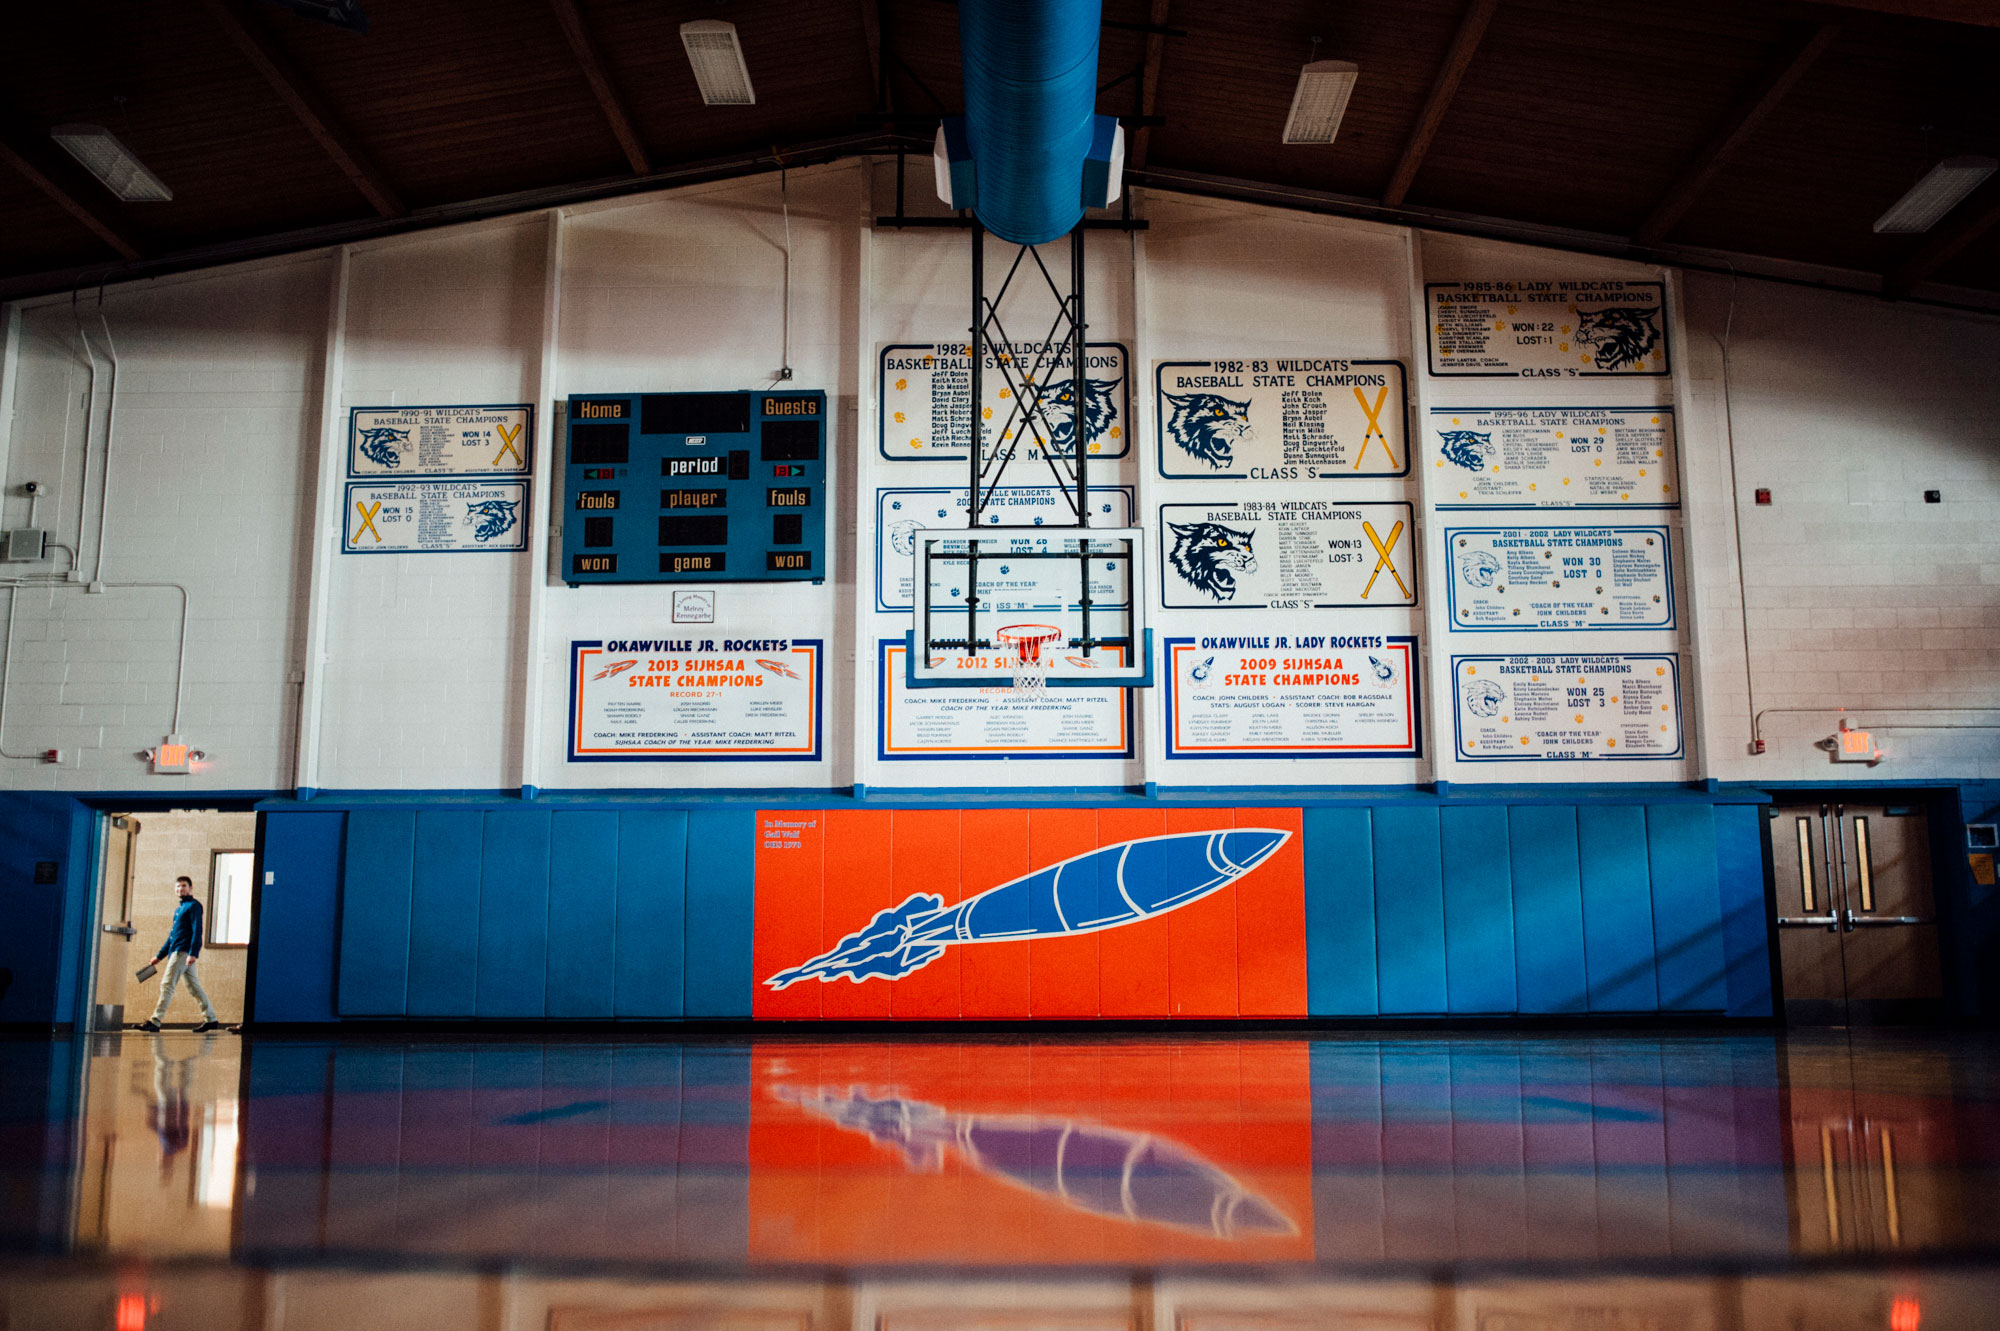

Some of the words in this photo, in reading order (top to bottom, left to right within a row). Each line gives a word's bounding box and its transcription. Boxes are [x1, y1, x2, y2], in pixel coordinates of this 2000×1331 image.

[1464, 282, 1512, 291] 1985-86
[1518, 282, 1550, 291] LADY
[1559, 282, 1623, 291] WILDCATS
[1437, 294, 1521, 303] BASKETBALL
[1527, 293, 1567, 302] STATE
[1575, 293, 1653, 302] CHAMPIONS
[995, 343, 1071, 354] WILDCATS
[985, 358, 1028, 369] STATE
[1277, 360, 1348, 372] WILDCATS
[1522, 369, 1561, 378] CLASS
[1176, 376, 1243, 388] BASEBALL
[1253, 375, 1295, 387] STATE
[1306, 375, 1385, 386] CHAMPIONS
[580, 402, 622, 418] Home
[765, 399, 816, 415] Guests
[1560, 410, 1606, 418] WILDCATS
[1572, 418, 1625, 426] CHAMPIONS
[670, 457, 718, 476] period
[777, 466, 786, 476] B
[1250, 468, 1298, 480] CLASS
[1305, 467, 1320, 478] "S"
[581, 493, 615, 509] fouls
[670, 492, 718, 508] player
[771, 490, 806, 505] fouls
[1008, 498, 1055, 506] CHAMPIONS
[1243, 502, 1276, 511] 1983-84
[1280, 502, 1327, 510] WILDCATS
[1207, 512, 1261, 521] BASEBALL
[1267, 512, 1297, 520] STATE
[1301, 511, 1362, 520] CHAMPIONS
[1492, 539, 1545, 548] BASKETBALL
[1547, 539, 1574, 547] STATE
[1575, 538, 1623, 547] CHAMPIONS
[581, 557, 610, 570] won
[674, 555, 711, 572] game
[775, 554, 804, 567] won
[1563, 557, 1584, 566] WON
[1589, 557, 1601, 566] 30
[1563, 570, 1587, 578] LOST
[1596, 570, 1601, 578] 0
[1270, 600, 1299, 609] CLASS
[1540, 620, 1569, 628] CLASS
[607, 640, 692, 652] OKAWVILLE
[697, 640, 718, 652] JR.
[724, 639, 788, 651] ROCKETS
[1202, 637, 1269, 649] OKAWVILLE
[1274, 637, 1292, 649] JR.
[1296, 636, 1327, 648] LADY
[1330, 636, 1382, 648] ROCKETS
[648, 660, 679, 672] 2013
[685, 660, 745, 671] SIJHSAA
[956, 657, 988, 669] 2012
[1240, 659, 1277, 670] 2009
[1283, 659, 1343, 670] SIJHSAA
[1499, 666, 1552, 674] BASKETBALL
[1556, 665, 1581, 673] STATE
[1584, 665, 1632, 673] CHAMPIONS
[629, 676, 670, 687] STATE
[677, 675, 763, 687] CHAMPIONS
[1224, 675, 1266, 686] STATE
[1273, 674, 1360, 686] CHAMPIONS
[1566, 688, 1587, 696] WON
[1592, 688, 1604, 696] 25
[1567, 699, 1590, 707] LOST
[1599, 699, 1605, 707] 3
[1843, 732, 1869, 754] EXIT
[160, 745, 187, 766] EXIT
[764, 820, 772, 828] In
[774, 820, 806, 829] Memory
[808, 820, 816, 828] of
